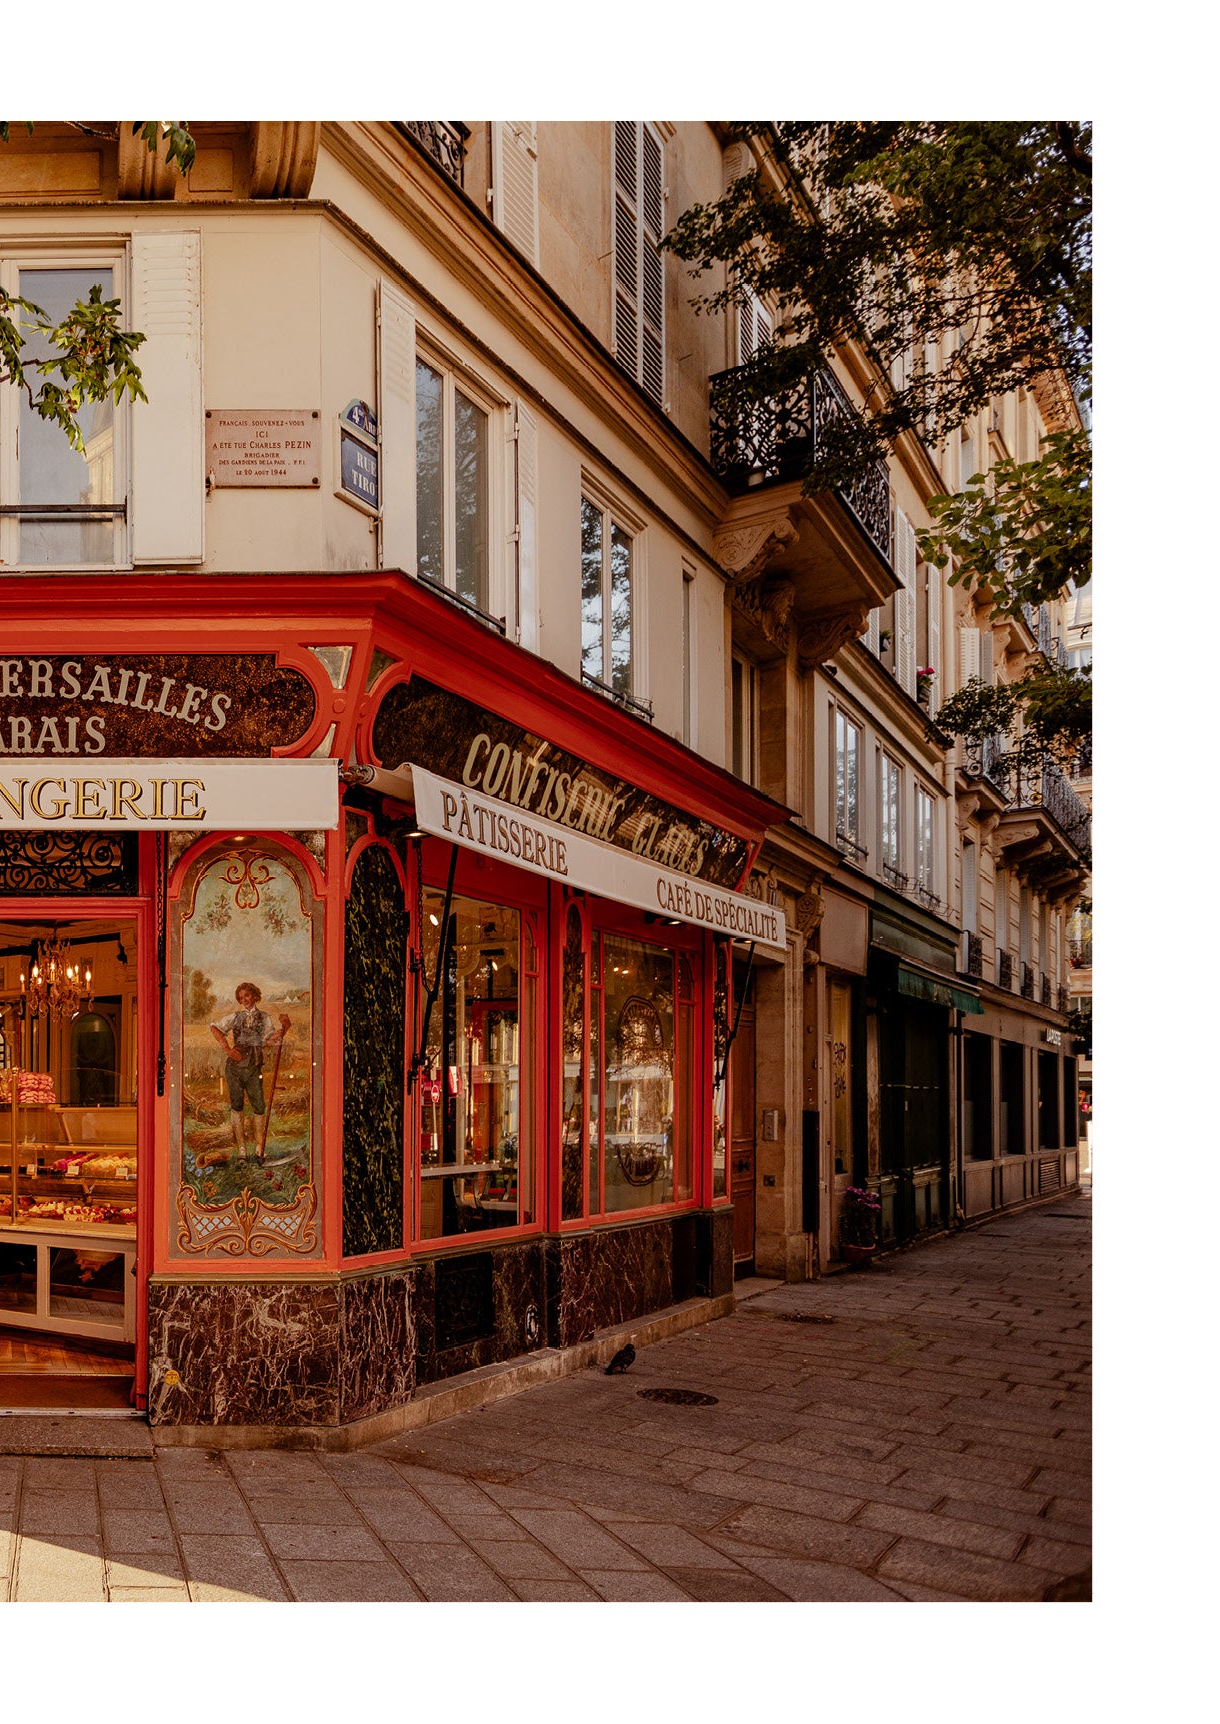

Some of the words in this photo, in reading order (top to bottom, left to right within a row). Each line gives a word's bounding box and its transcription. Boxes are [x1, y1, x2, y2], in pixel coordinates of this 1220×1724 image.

[285, 441, 312, 449] PEZIN
[356, 451, 377, 477] RUE
[440, 789, 568, 876] PÂTISSERIE
[462, 733, 626, 843] CONFISERIE
[632, 812, 709, 876] GLACES
[656, 876, 693, 918] CAFÉ
[694, 890, 714, 923] DE
[714, 896, 778, 942] SPÉCIALITÉ
